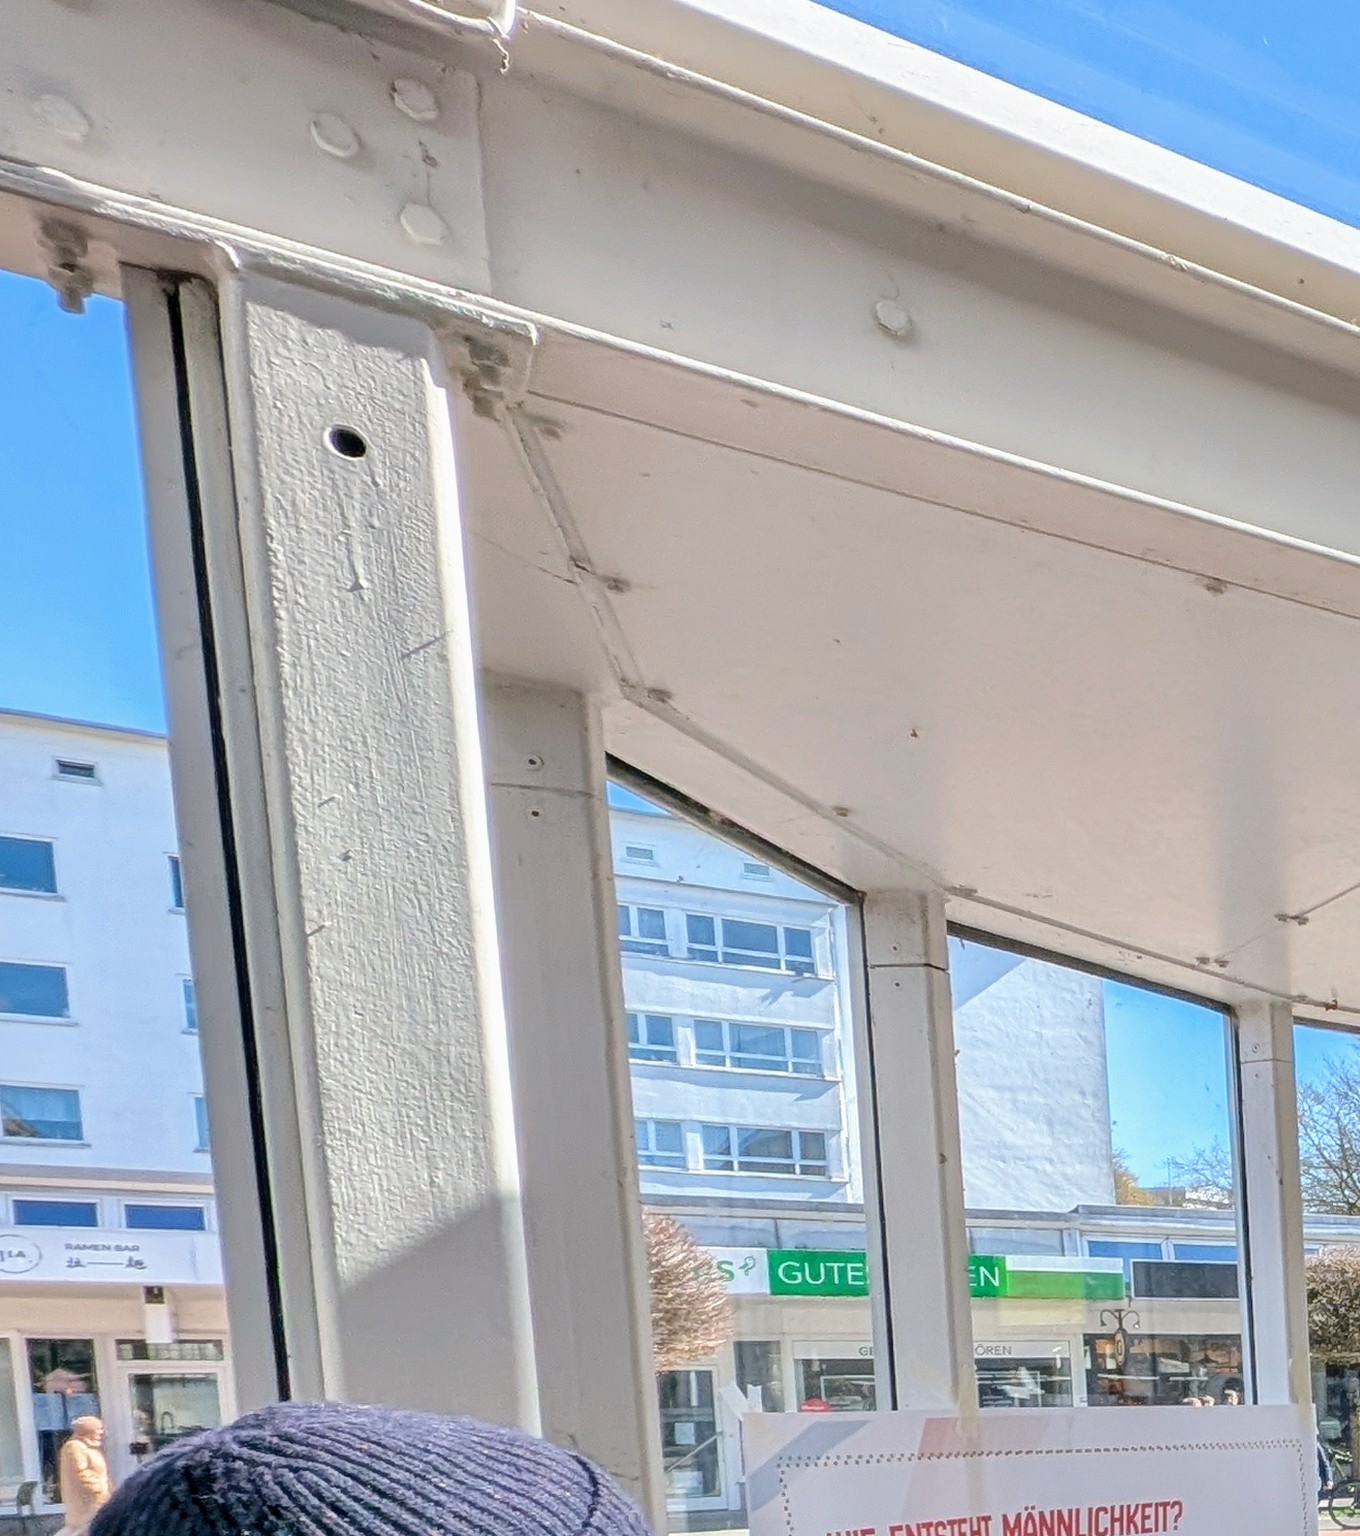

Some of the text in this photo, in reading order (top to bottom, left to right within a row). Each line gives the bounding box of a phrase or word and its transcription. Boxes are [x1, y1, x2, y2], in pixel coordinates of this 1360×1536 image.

[64, 1243, 140, 1252] RAMEN BAR
[777, 1262, 871, 1286] GUTE
[975, 1342, 1012, 1355] ÖREN
